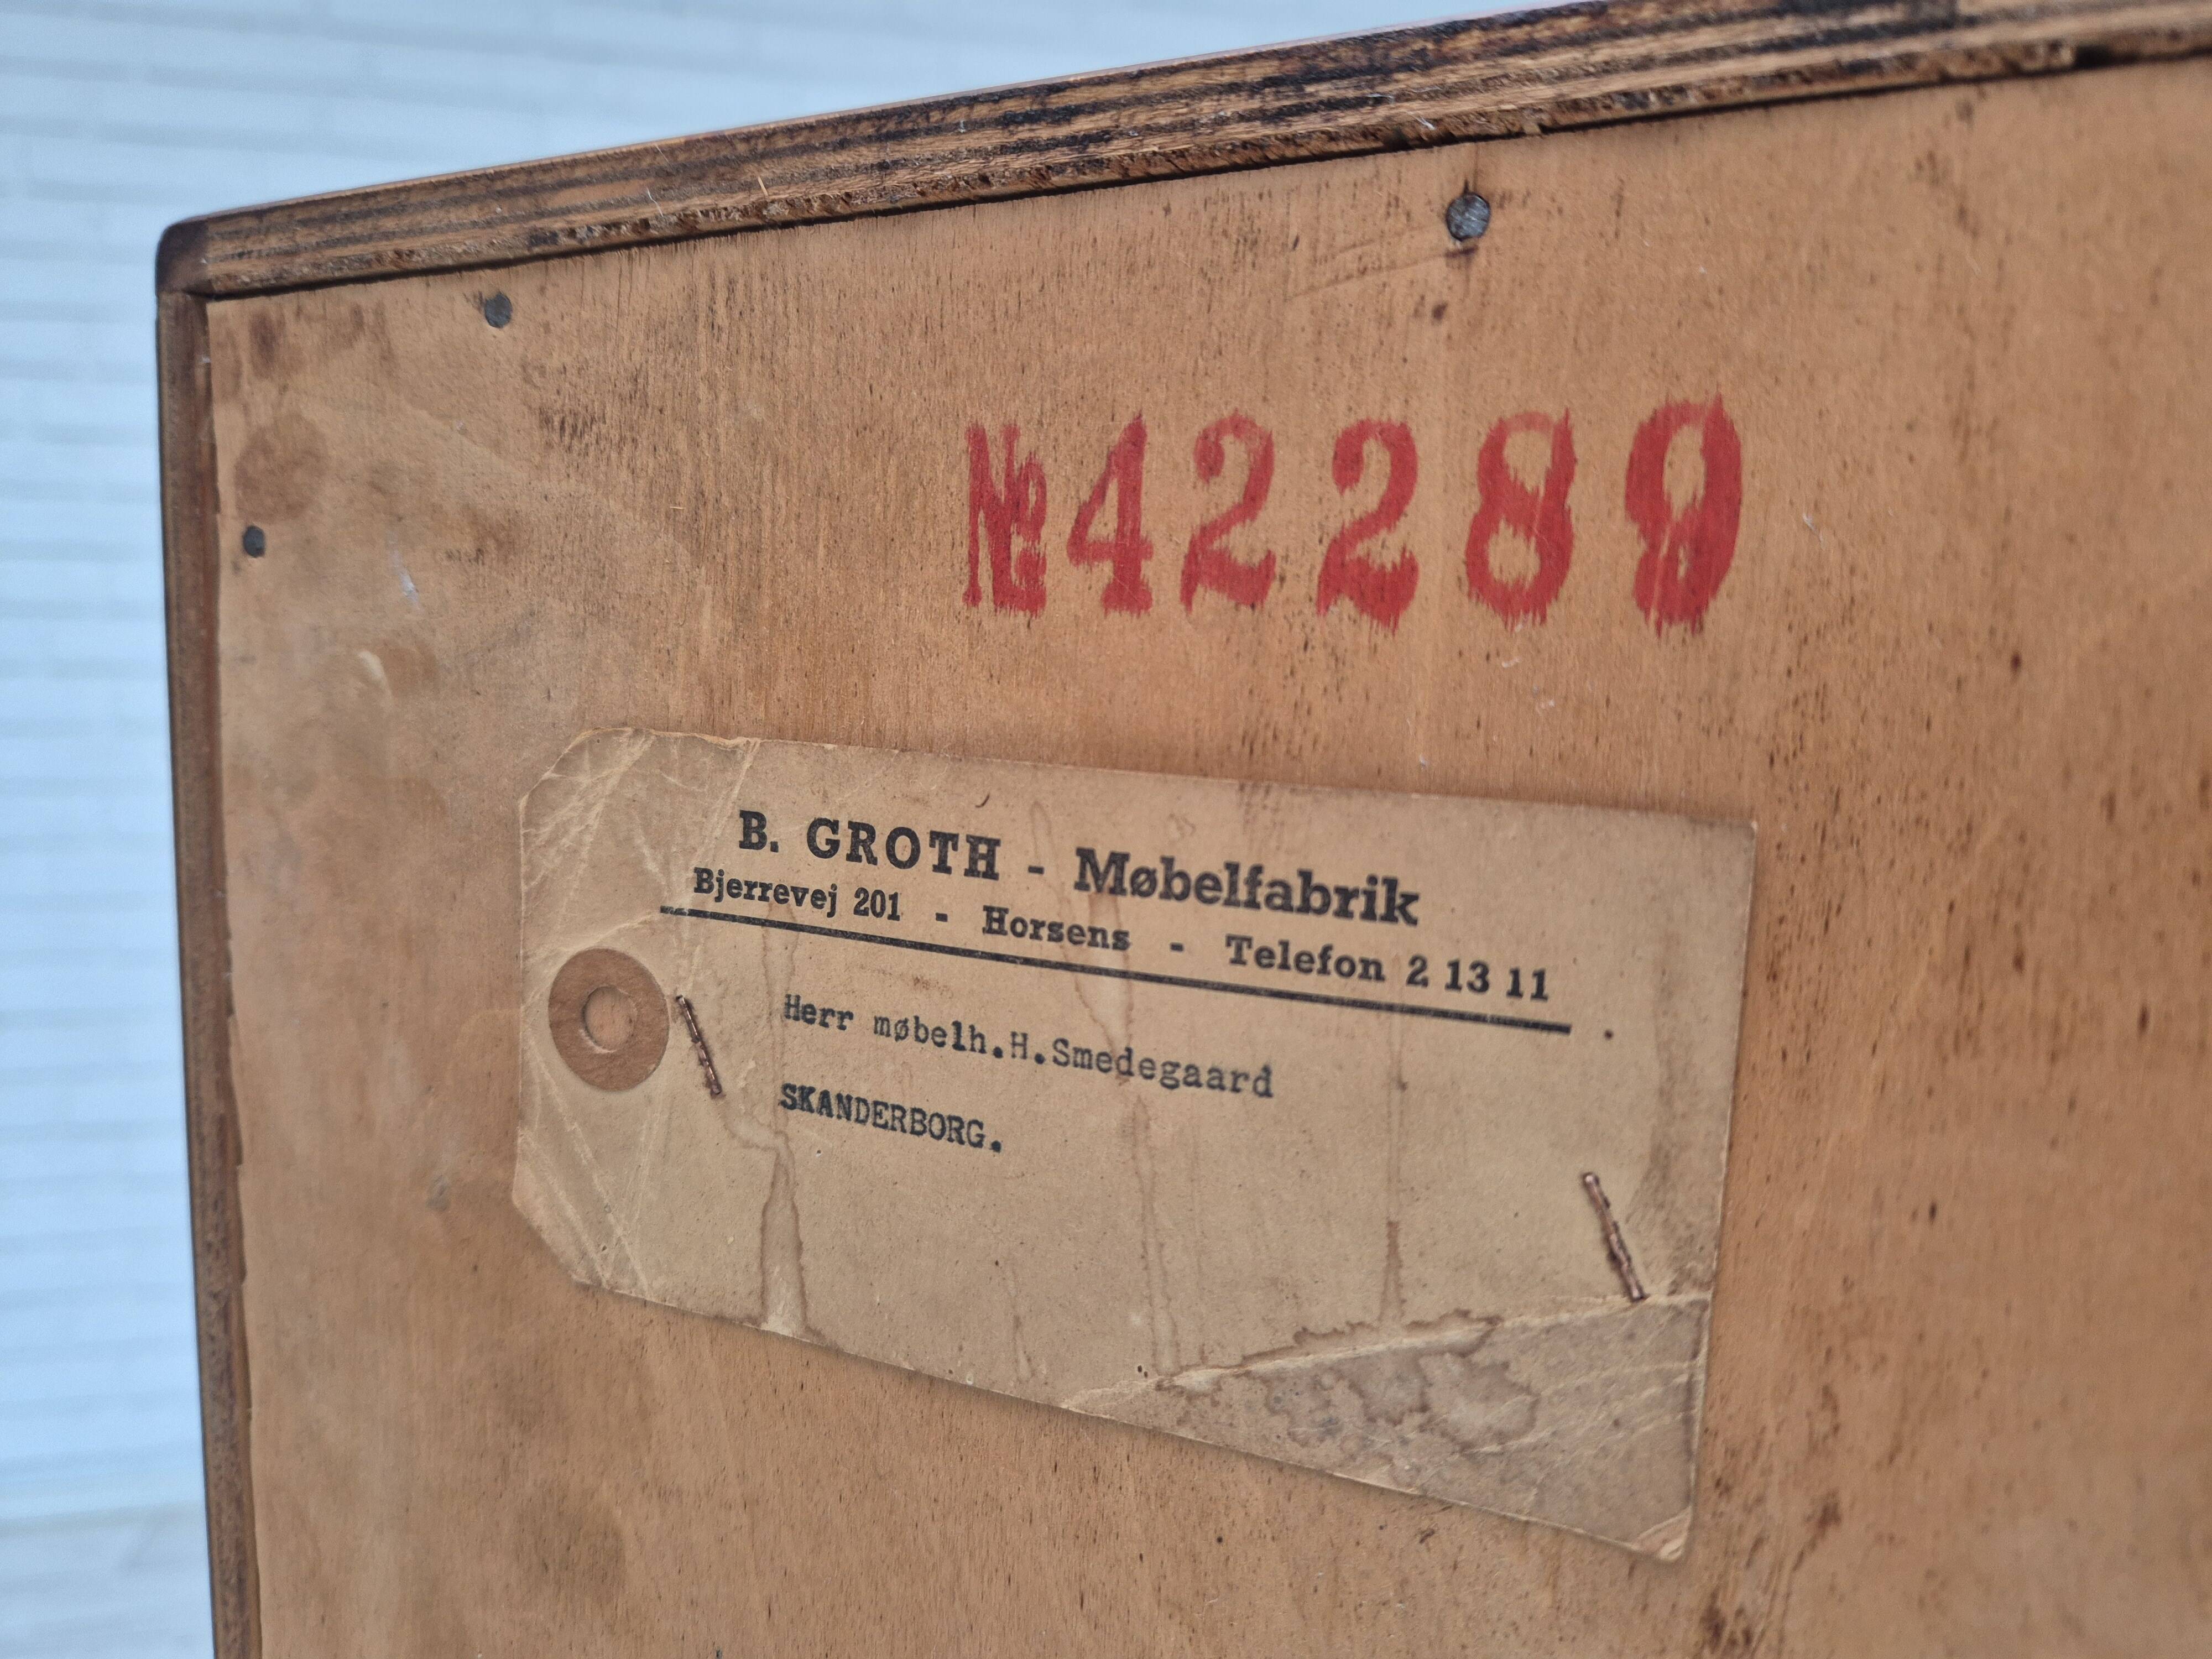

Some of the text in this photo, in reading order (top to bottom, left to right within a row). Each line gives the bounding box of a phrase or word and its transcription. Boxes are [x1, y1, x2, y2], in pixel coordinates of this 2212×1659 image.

[1066, 390, 1743, 637] 42289
[739, 810, 1421, 926] B. GROTH - Møbelfabrik
[693, 867, 1550, 1002] Bjerrevej 201 - Horsens - Telefon 2 13 11
[784, 994, 854, 1031] Herr
[780, 1083, 1003, 1153] SKANDERBORG.
